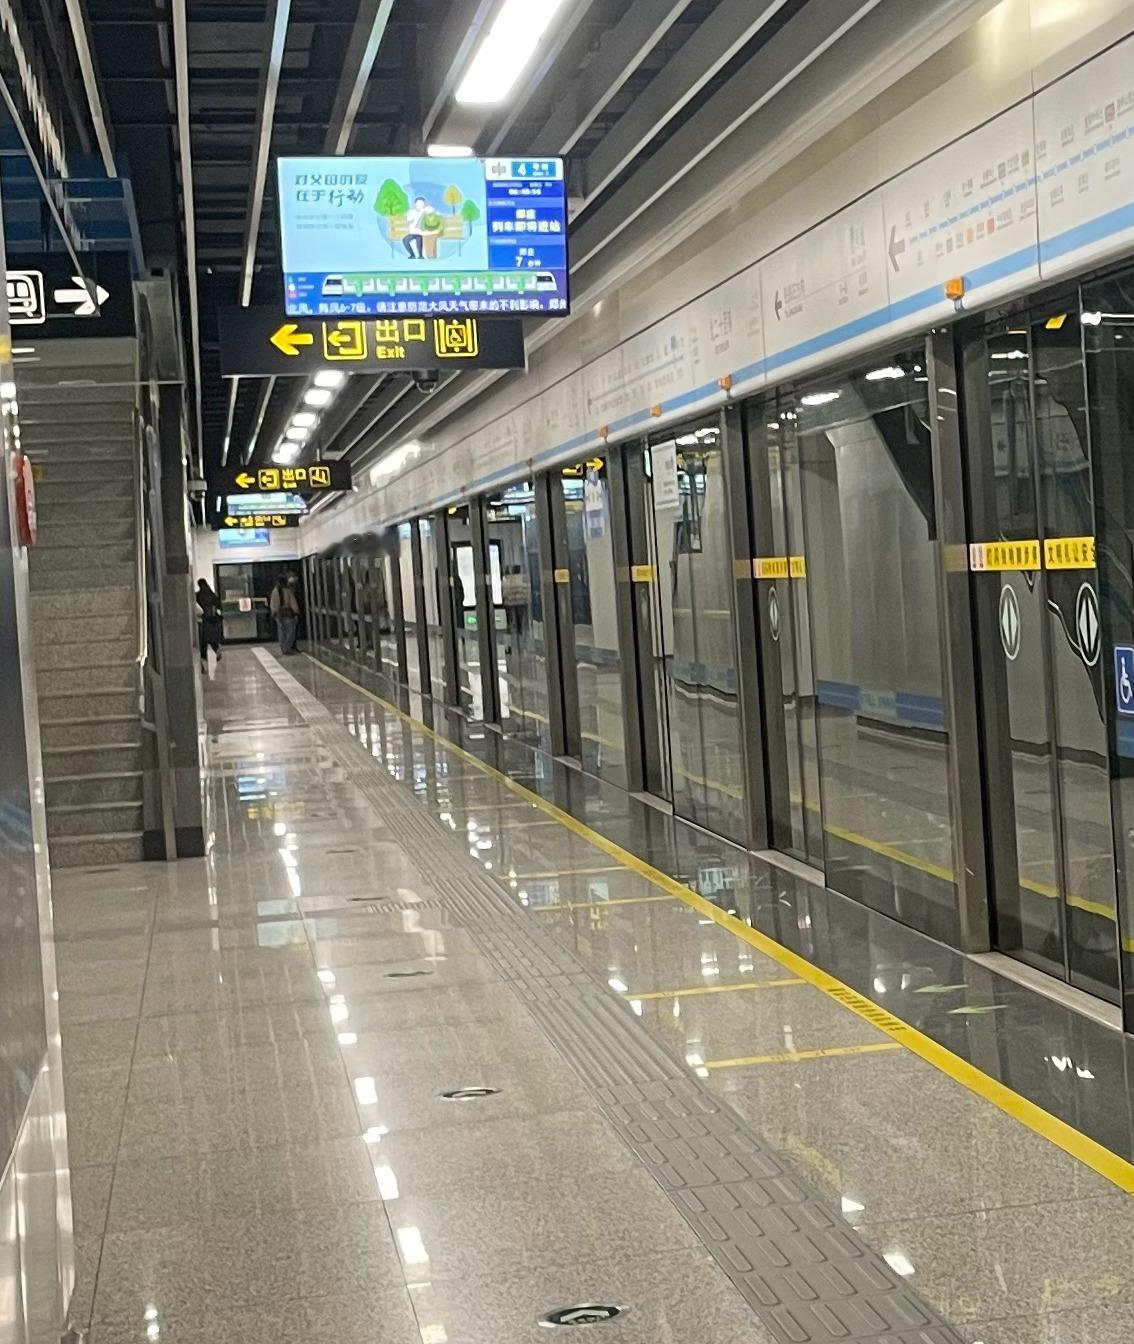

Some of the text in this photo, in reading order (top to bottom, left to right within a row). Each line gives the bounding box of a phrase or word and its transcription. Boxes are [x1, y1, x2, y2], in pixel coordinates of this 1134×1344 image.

[296, 189, 365, 208] 在于行动
[376, 319, 425, 342] 出口
[376, 346, 405, 359] Exit
